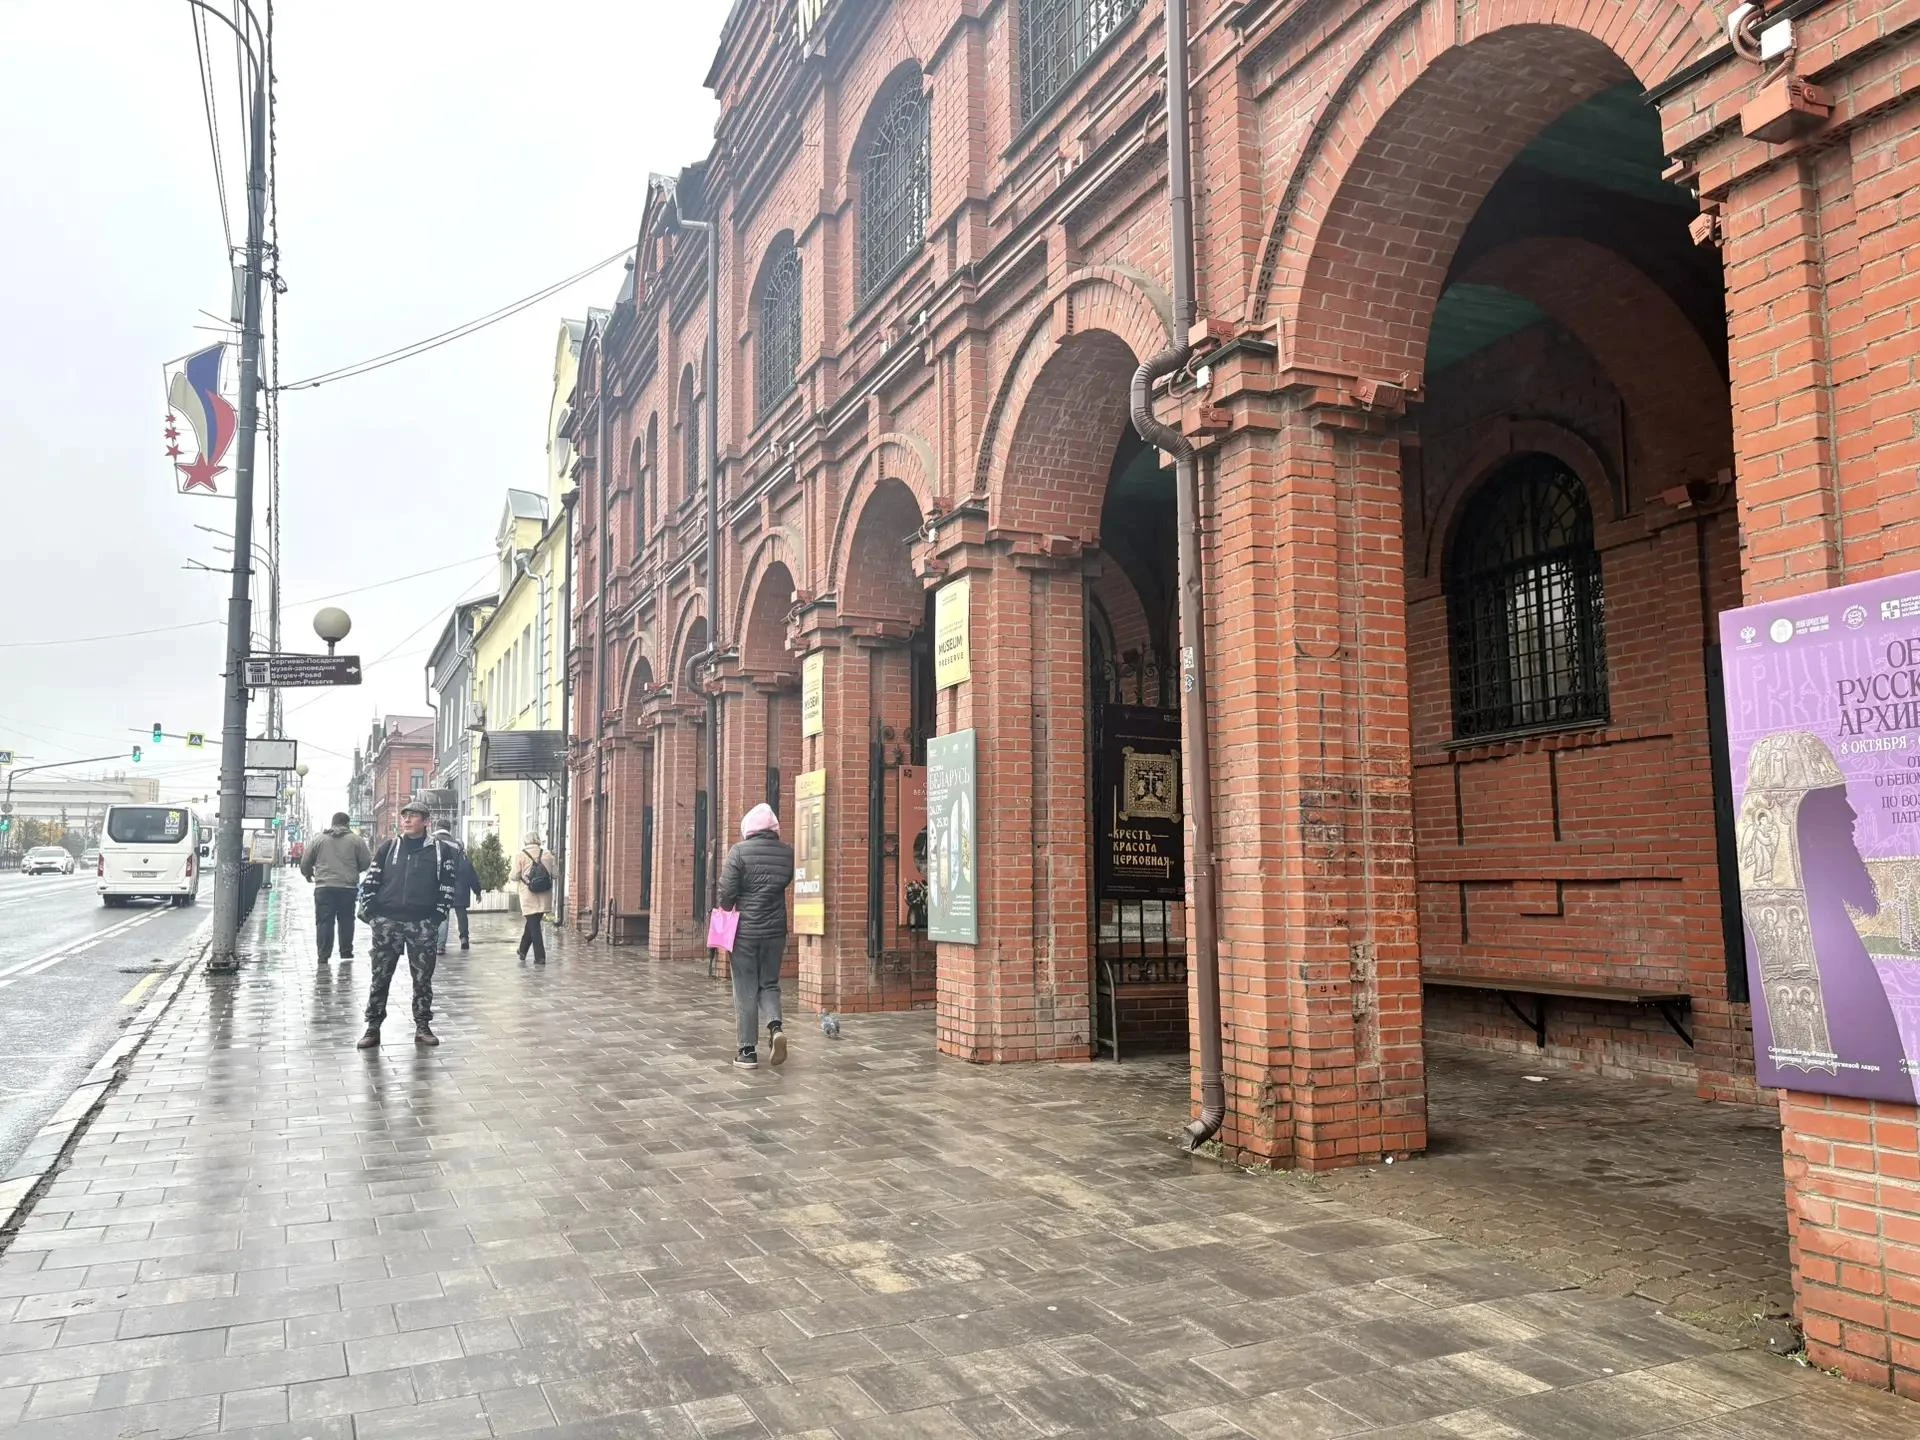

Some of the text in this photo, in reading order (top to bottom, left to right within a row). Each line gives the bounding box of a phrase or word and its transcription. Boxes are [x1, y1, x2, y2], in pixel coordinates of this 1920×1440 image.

[938, 634, 963, 655] MUSEUM
[270, 657, 345, 665] Сергиево-Посадский
[938, 652, 964, 667] PRESERVE
[1840, 735, 1907, 755] 8 ОКТЯБРЯ
[928, 766, 970, 790] БЕЛАРУСЬ
[1112, 841, 1157, 853] КРАСОТА
